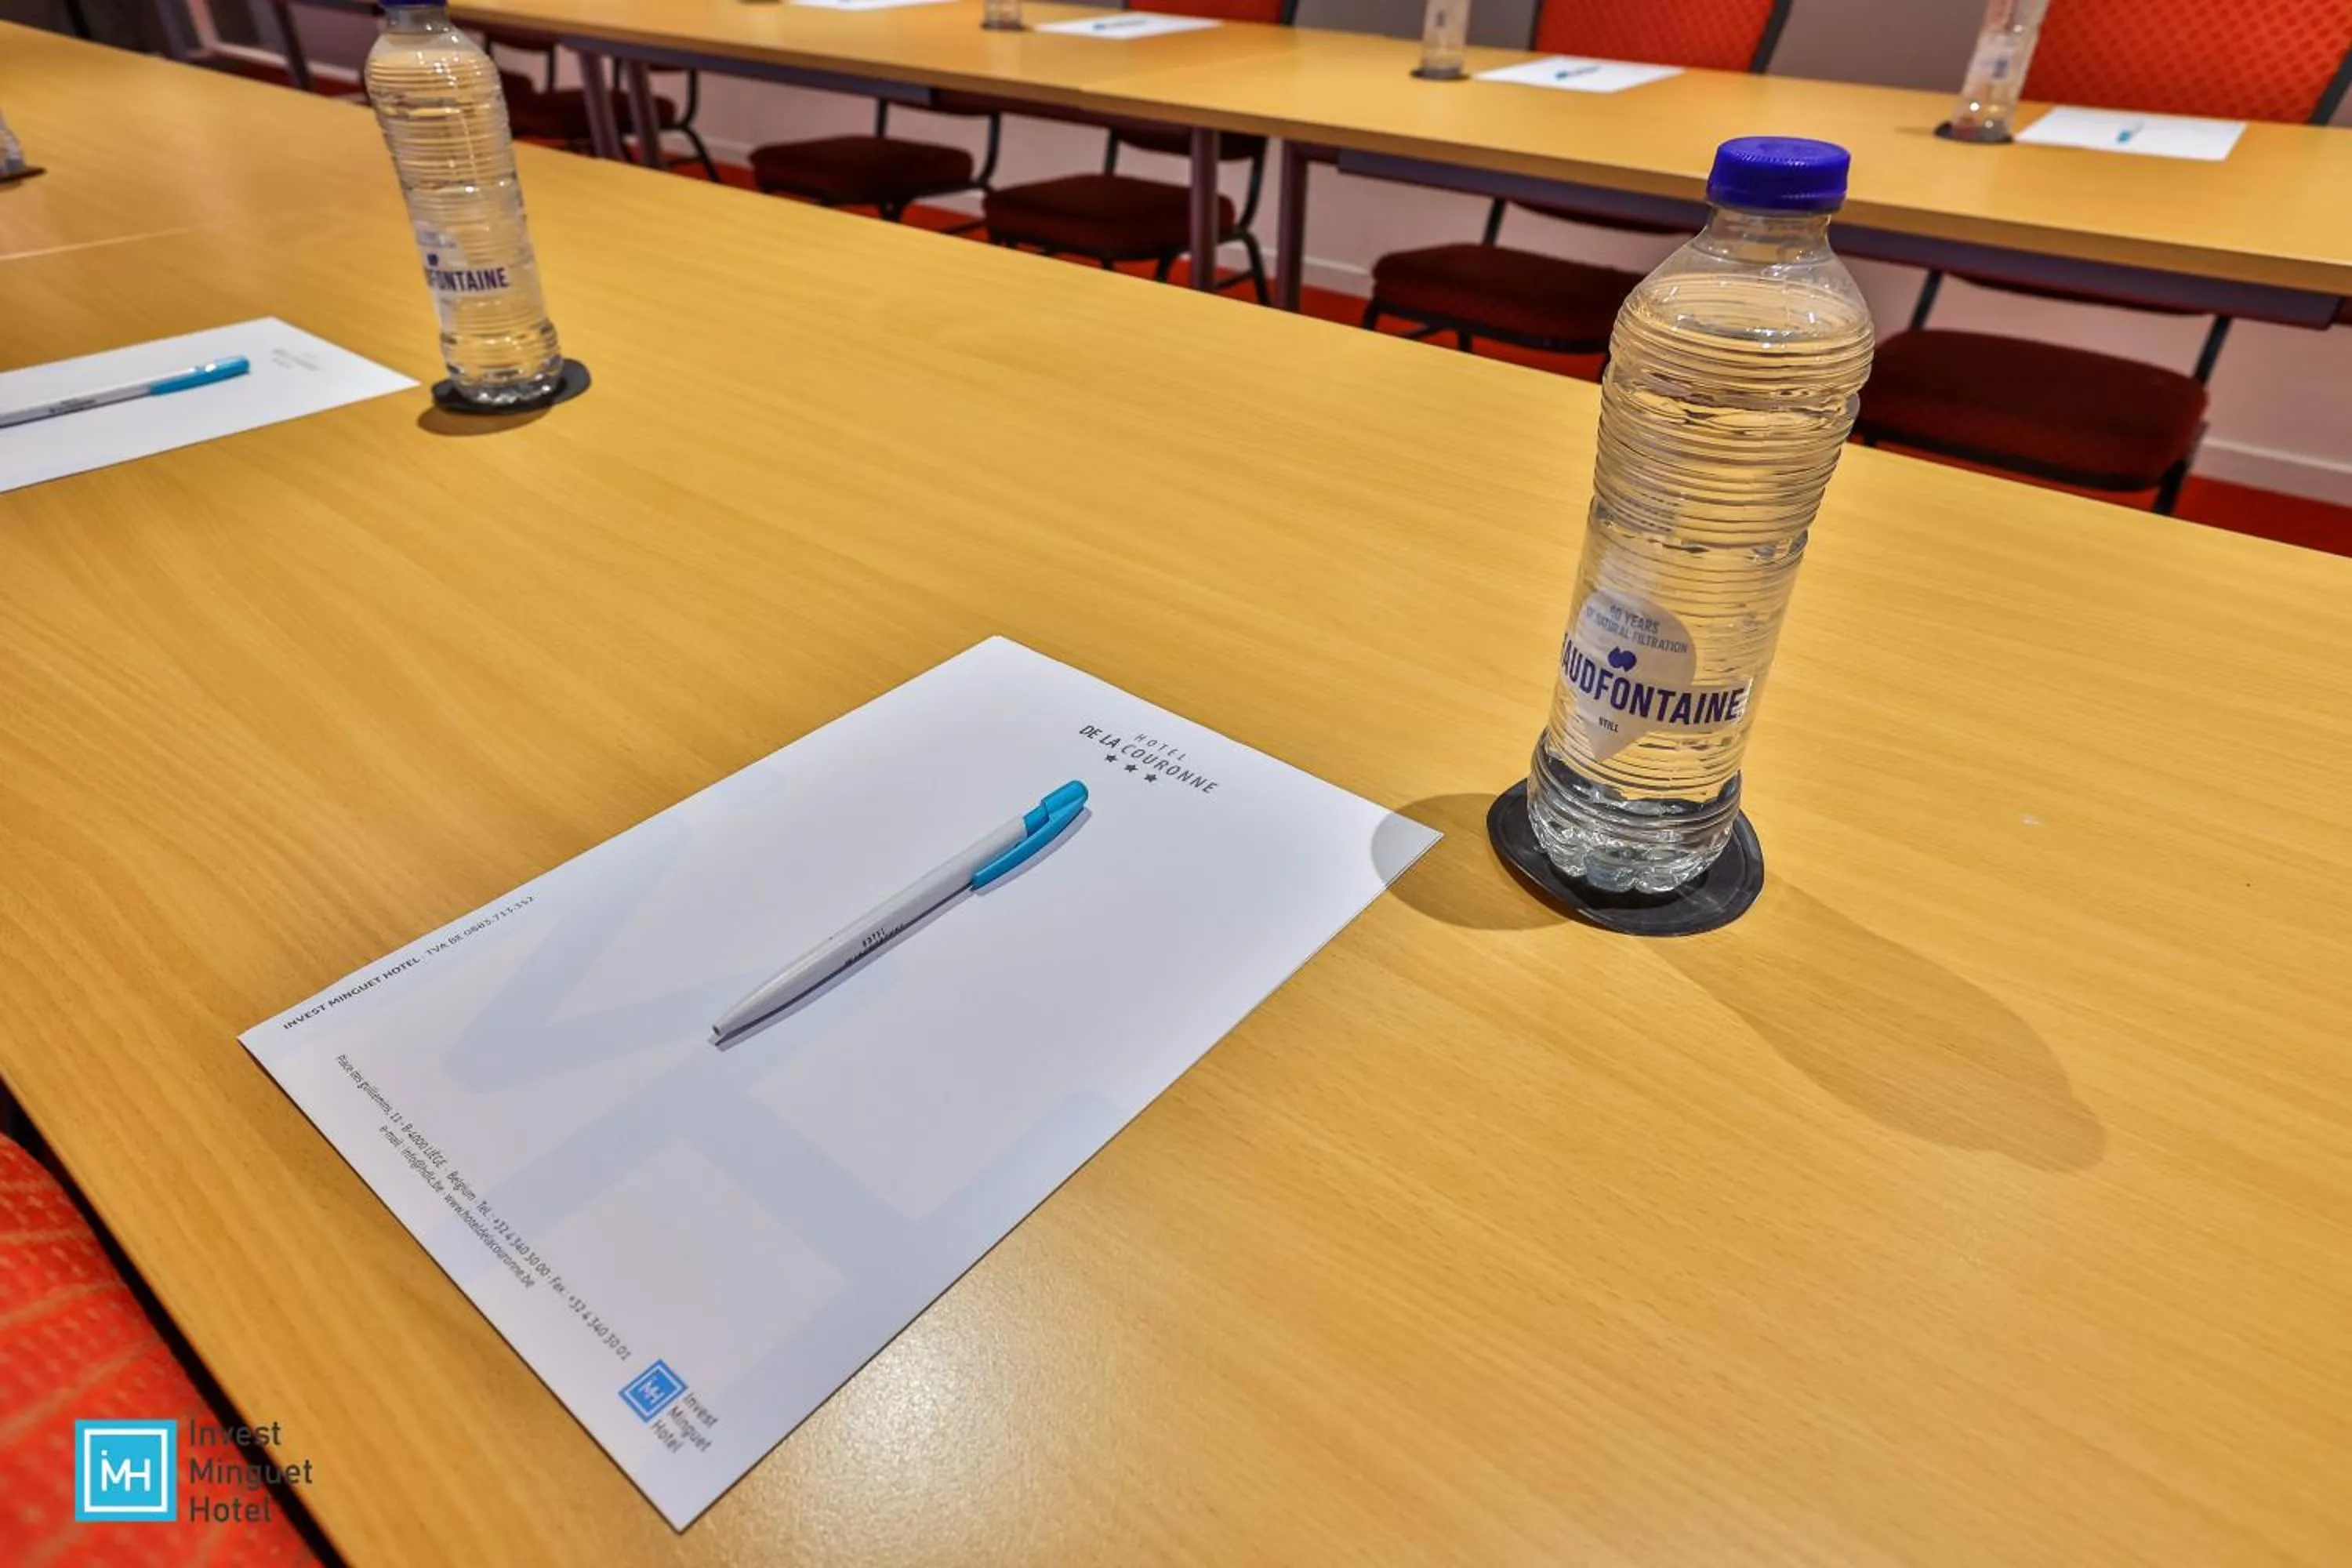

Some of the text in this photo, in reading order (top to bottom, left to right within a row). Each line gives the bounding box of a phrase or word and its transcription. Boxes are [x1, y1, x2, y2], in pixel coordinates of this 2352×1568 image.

[1624, 610, 1661, 633] YEARS
[1632, 631, 1688, 653] FILTRATION
[1599, 717, 1619, 733] STILL
[1133, 733, 1187, 762] HOTEL
[1079, 724, 1218, 794] DE LA COURONNE
[283, 1004, 326, 1029] INVEST
[328, 975, 383, 1007] MINGUET
[383, 957, 422, 979] HOTEL
[446, 1171, 476, 1201] Belgium
[524, 1252, 540, 1266] 30
[535, 1262, 550, 1276] 00
[549, 1276, 565, 1293] Fax
[568, 1295, 586, 1313] +32
[582, 1311, 593, 1320] 4
[587, 1316, 609, 1337] 340
[602, 1333, 620, 1348] 30
[615, 1345, 631, 1361] 01
[684, 1392, 719, 1428] Invest
[651, 1418, 684, 1454] Hotel
[667, 1405, 712, 1453] Minguet
